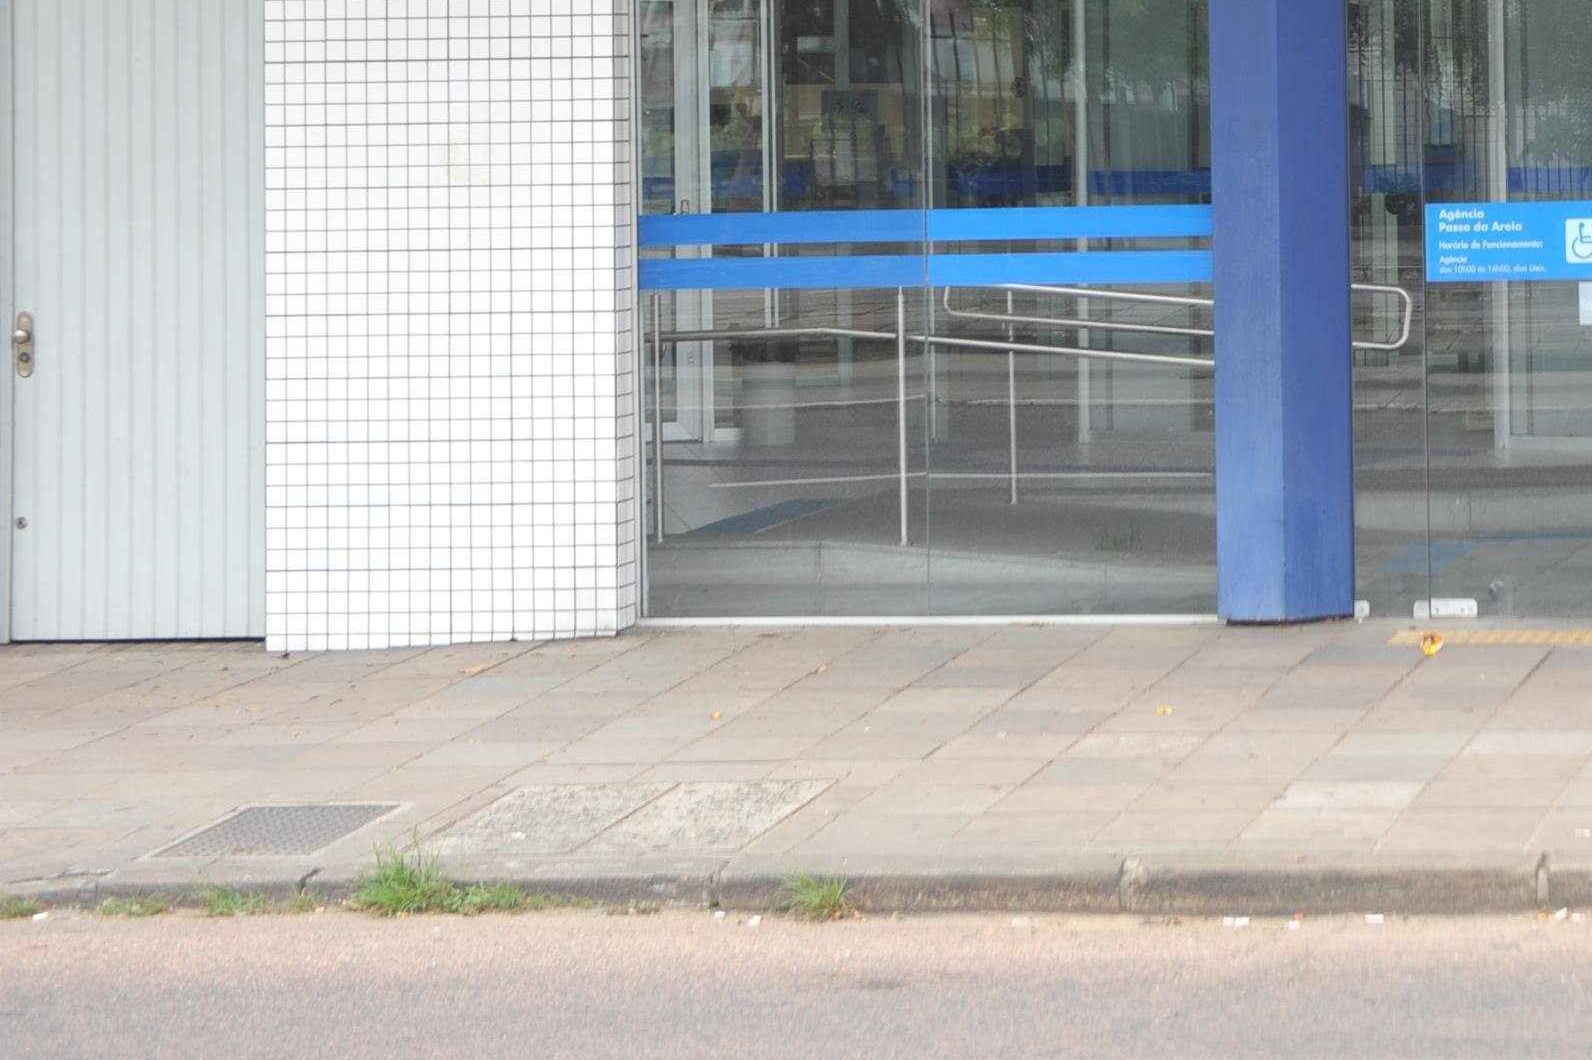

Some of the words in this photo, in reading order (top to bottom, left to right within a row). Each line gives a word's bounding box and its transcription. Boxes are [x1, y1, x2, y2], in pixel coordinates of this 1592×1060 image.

[1439, 208, 1485, 221] Agência
[1439, 222, 1471, 233] Passo
[1473, 221, 1489, 232] da
[1491, 221, 1523, 232] Areia
[1439, 240, 1469, 250] Horário
[1470, 240, 1481, 249] de
[1440, 255, 1468, 265] Agência
[1440, 266, 1452, 274] das
